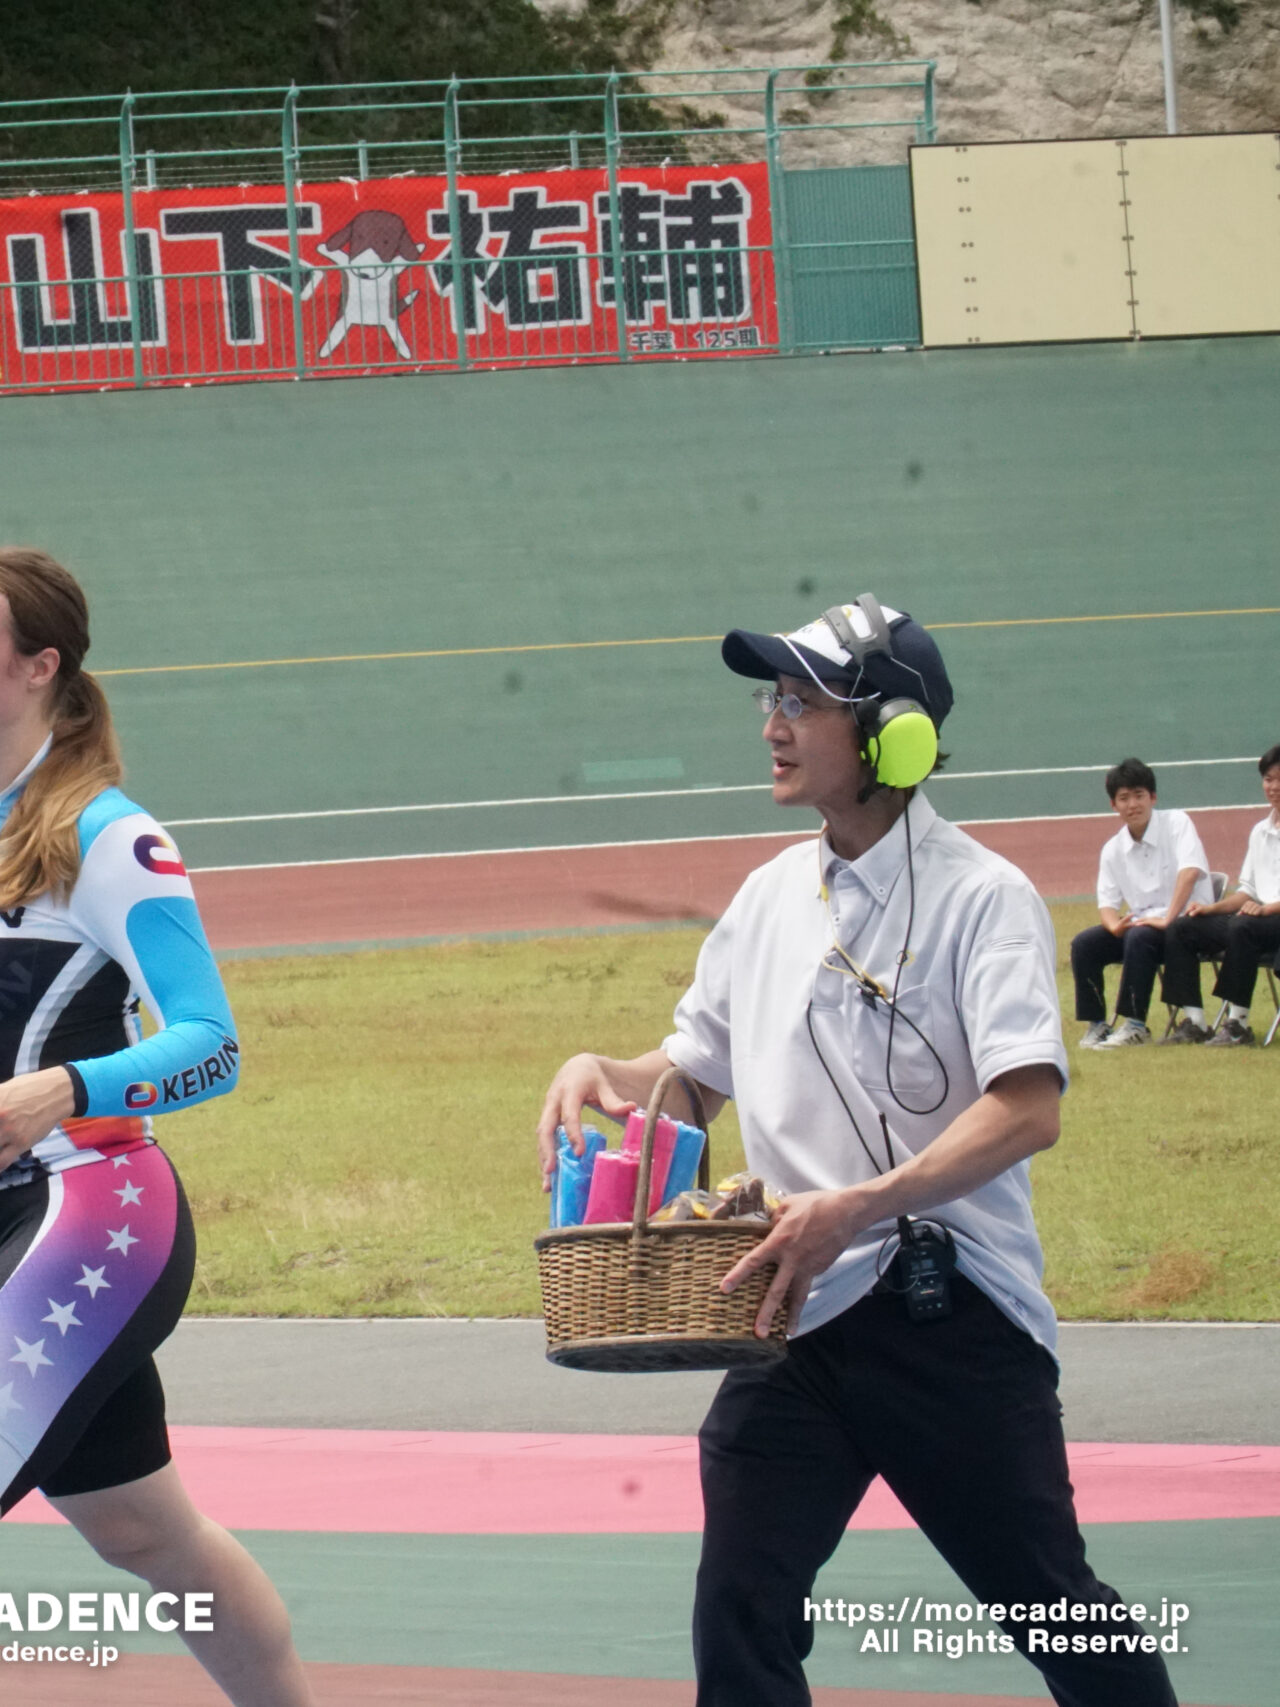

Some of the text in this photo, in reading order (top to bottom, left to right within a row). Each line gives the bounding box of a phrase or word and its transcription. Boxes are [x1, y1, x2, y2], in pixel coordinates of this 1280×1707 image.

[5, 201, 323, 355] 山下
[629, 325, 762, 351] 千葉 125期
[162, 1033, 241, 1105] KEIRIN
